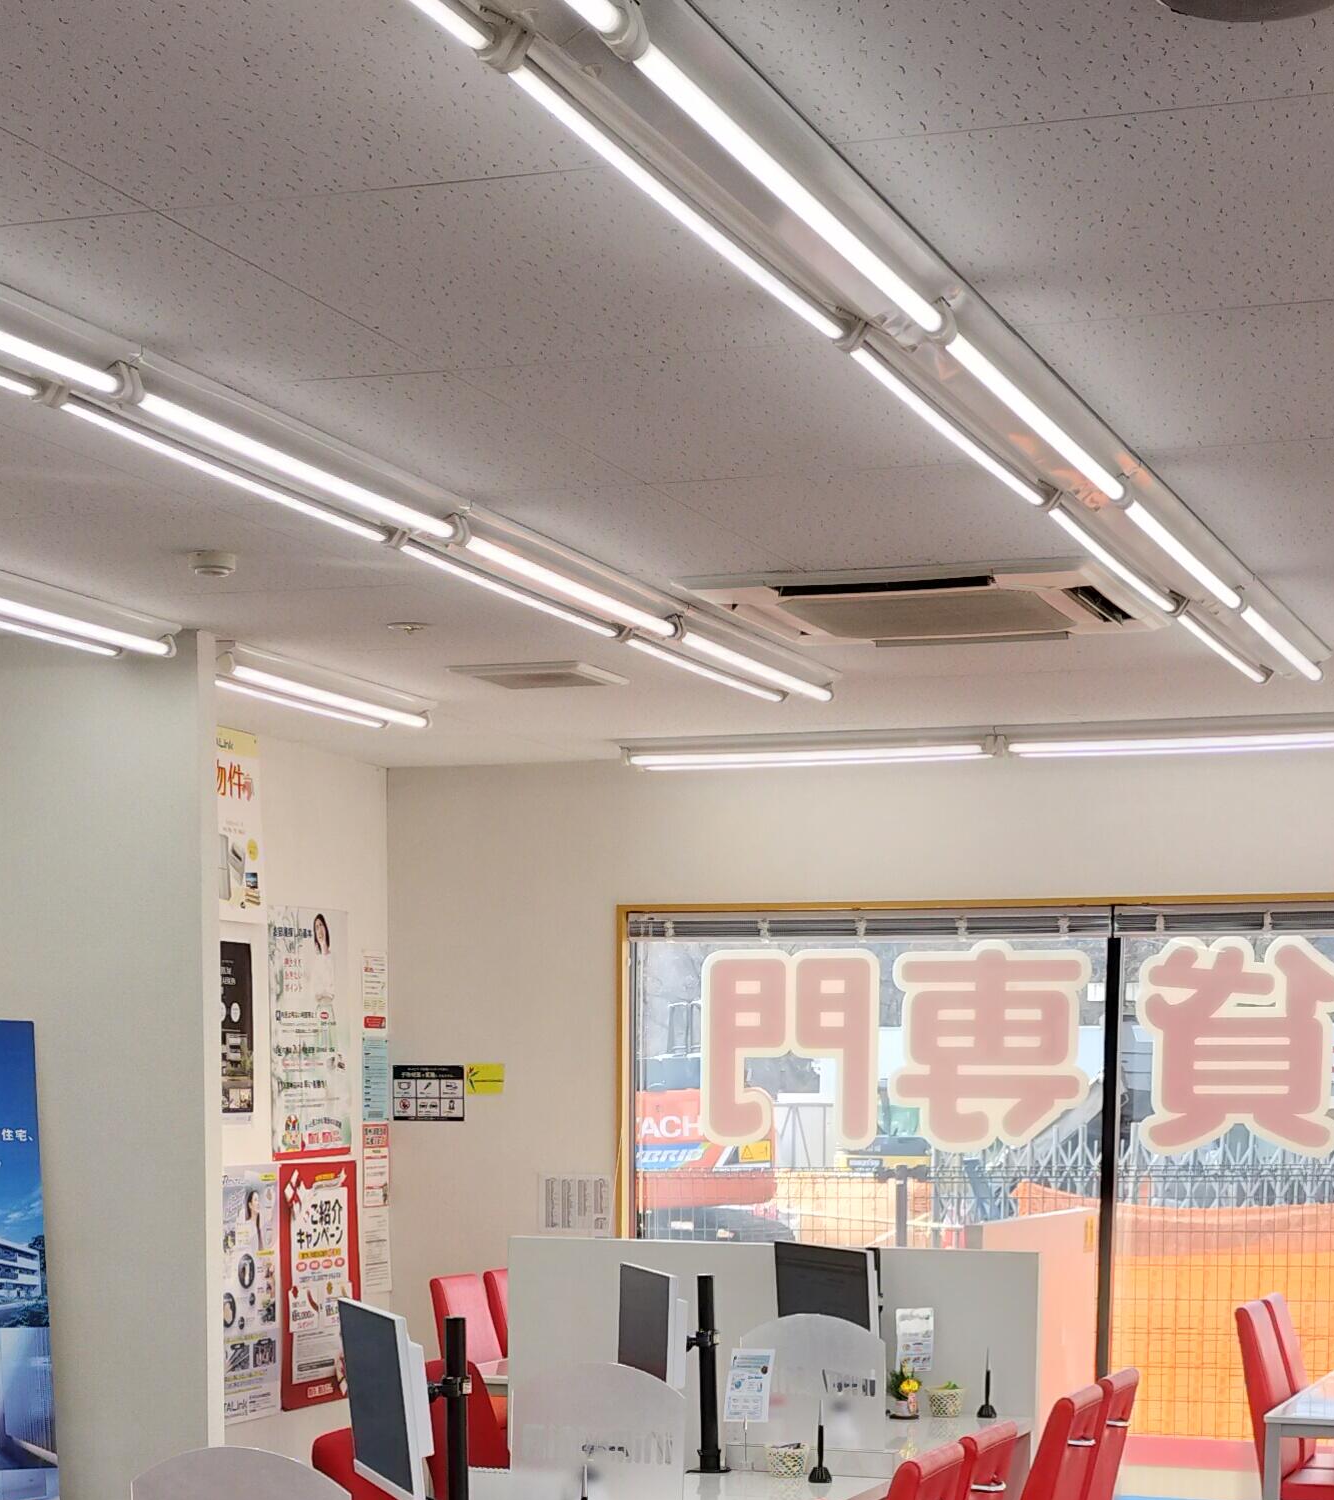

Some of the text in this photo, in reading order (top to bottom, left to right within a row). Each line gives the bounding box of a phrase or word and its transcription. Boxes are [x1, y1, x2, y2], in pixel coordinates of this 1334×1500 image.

[310, 1199, 343, 1225] ご紹介
[296, 1226, 343, 1249] キャンペーン
